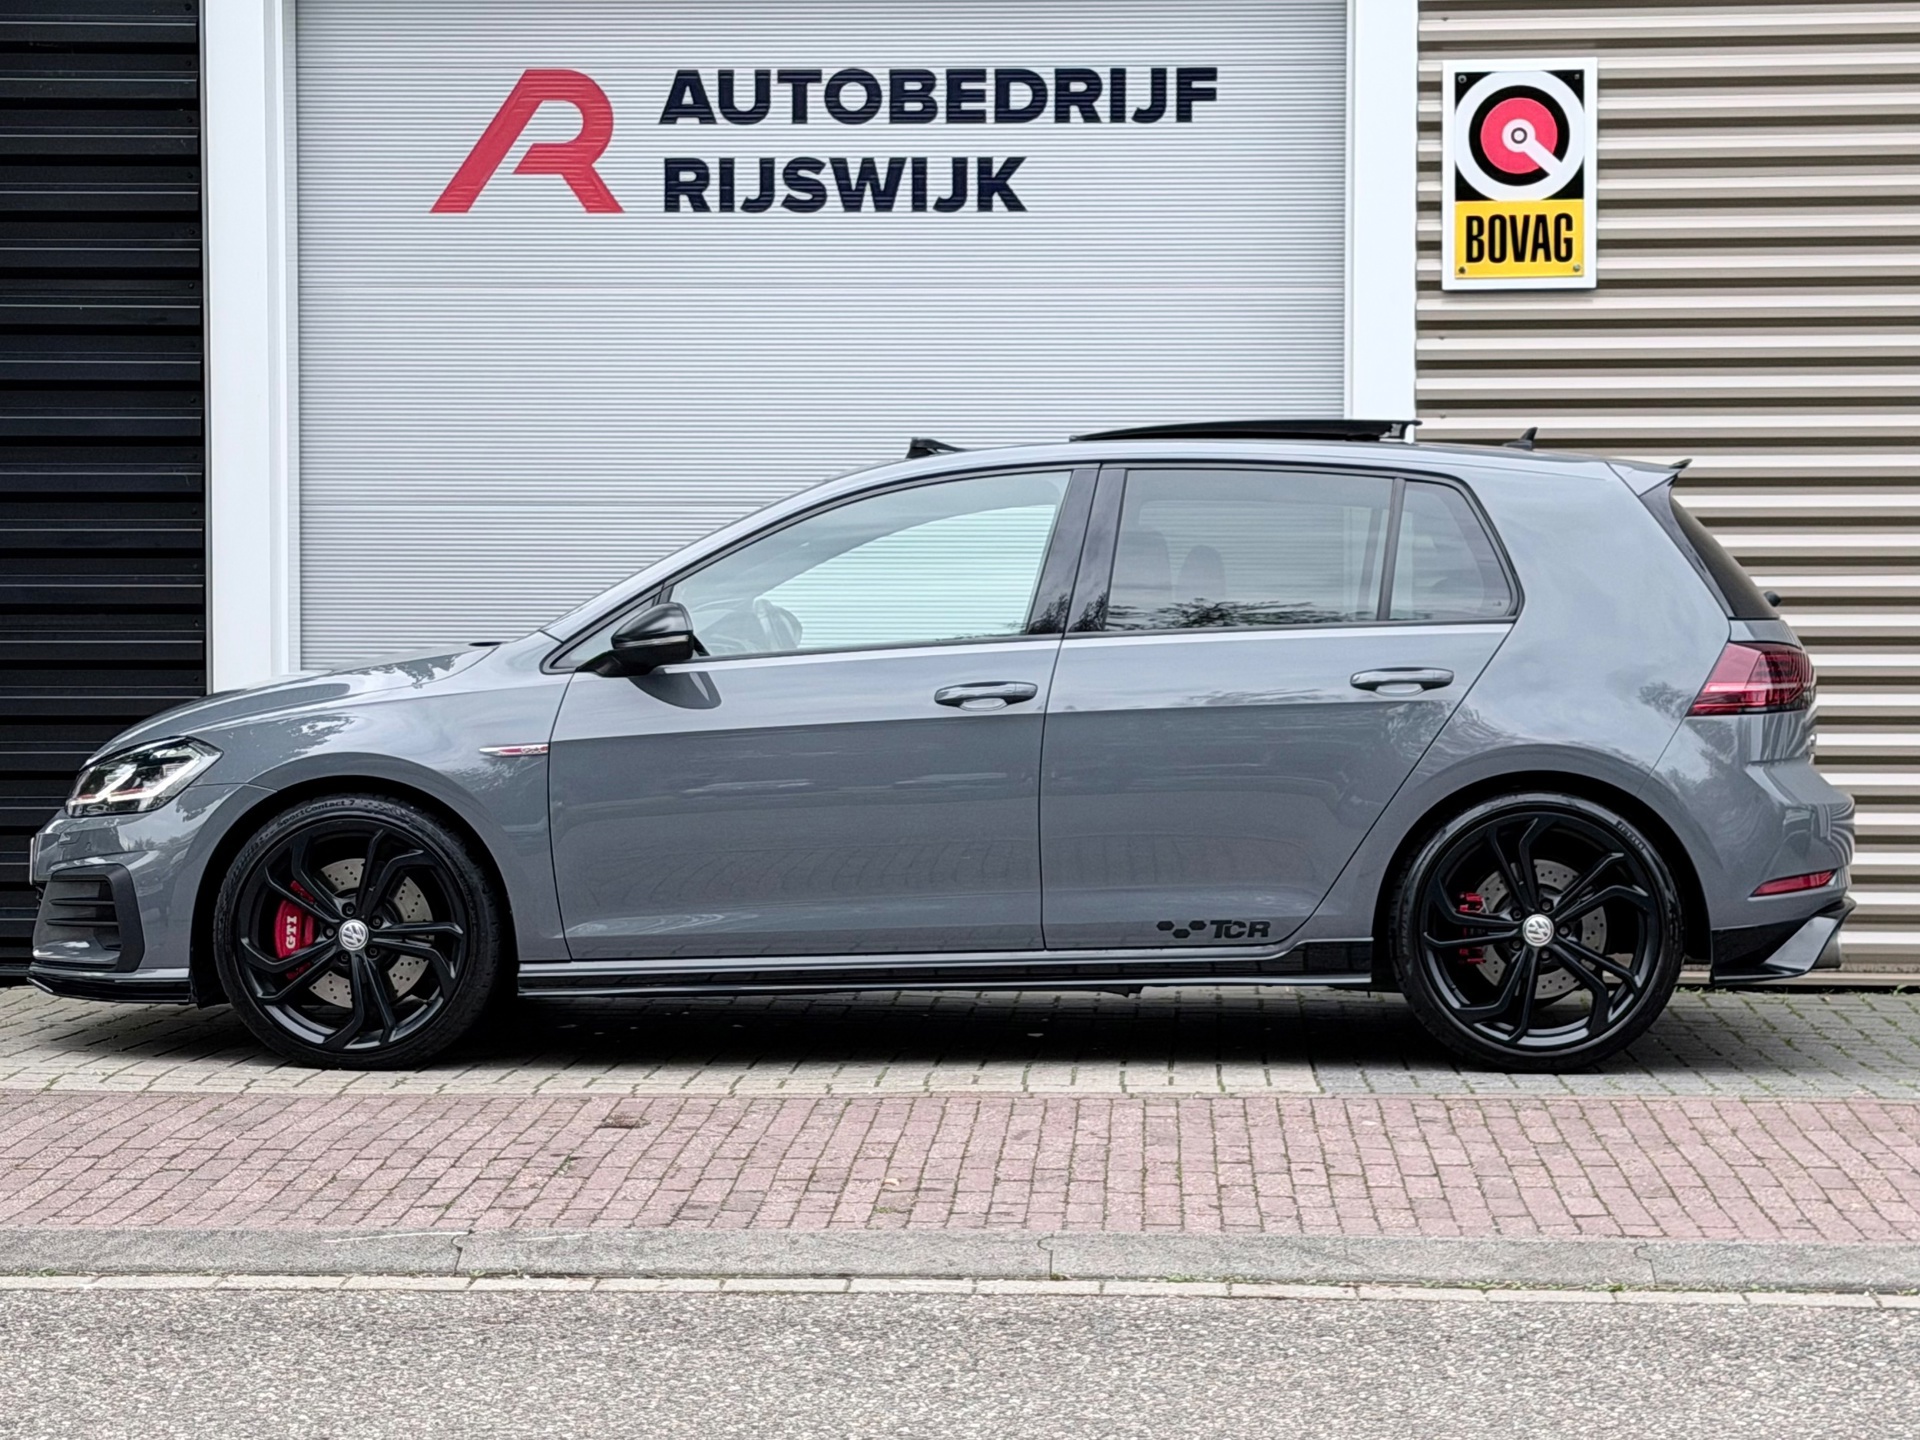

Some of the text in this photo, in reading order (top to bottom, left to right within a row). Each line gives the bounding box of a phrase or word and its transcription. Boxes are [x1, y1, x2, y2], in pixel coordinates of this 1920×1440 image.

[660, 68, 1219, 126] AUTOBEDRIJF
[664, 157, 1028, 214] RIJSWIJK
[1465, 213, 1574, 264] BOVAG
[285, 915, 297, 949] GTI
[1209, 919, 1272, 939] TCR
